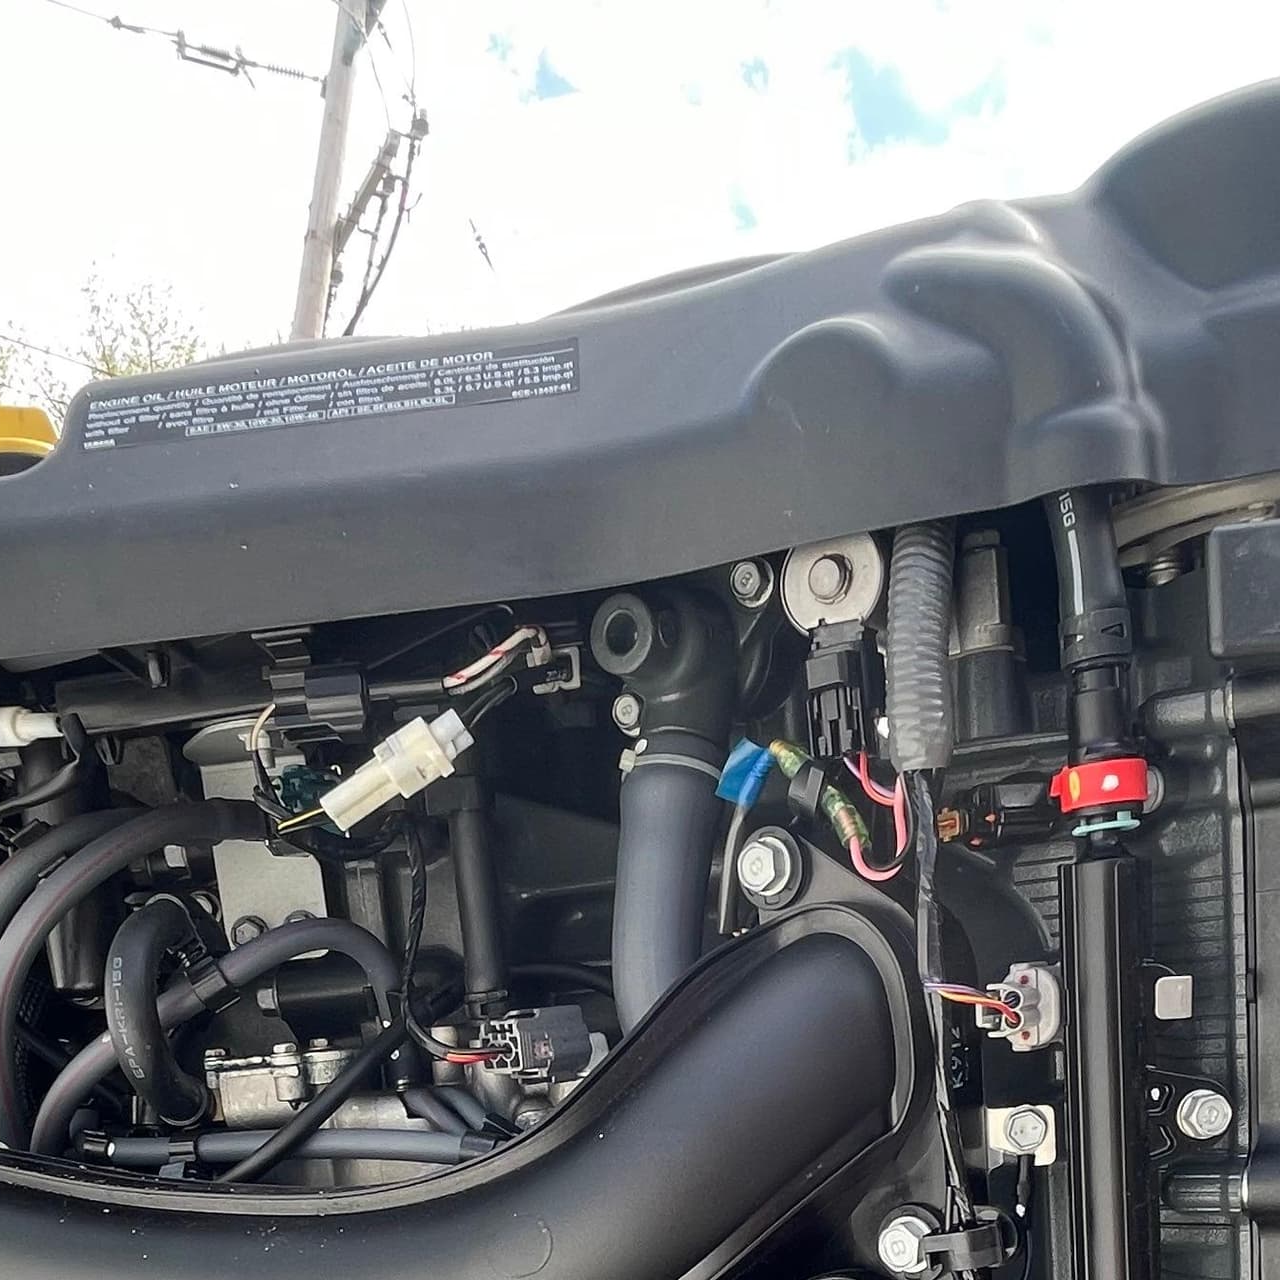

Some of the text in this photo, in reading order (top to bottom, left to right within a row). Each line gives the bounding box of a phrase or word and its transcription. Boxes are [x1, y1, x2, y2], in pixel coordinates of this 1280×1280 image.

[90, 396, 138, 409] ENGINE
[142, 392, 164, 403] OIL
[175, 385, 216, 398] HUILE
[219, 378, 276, 392] MOTEUR
[366, 360, 416, 374] ACEITE
[421, 358, 438, 367] DE
[443, 351, 492, 364] MOTOR
